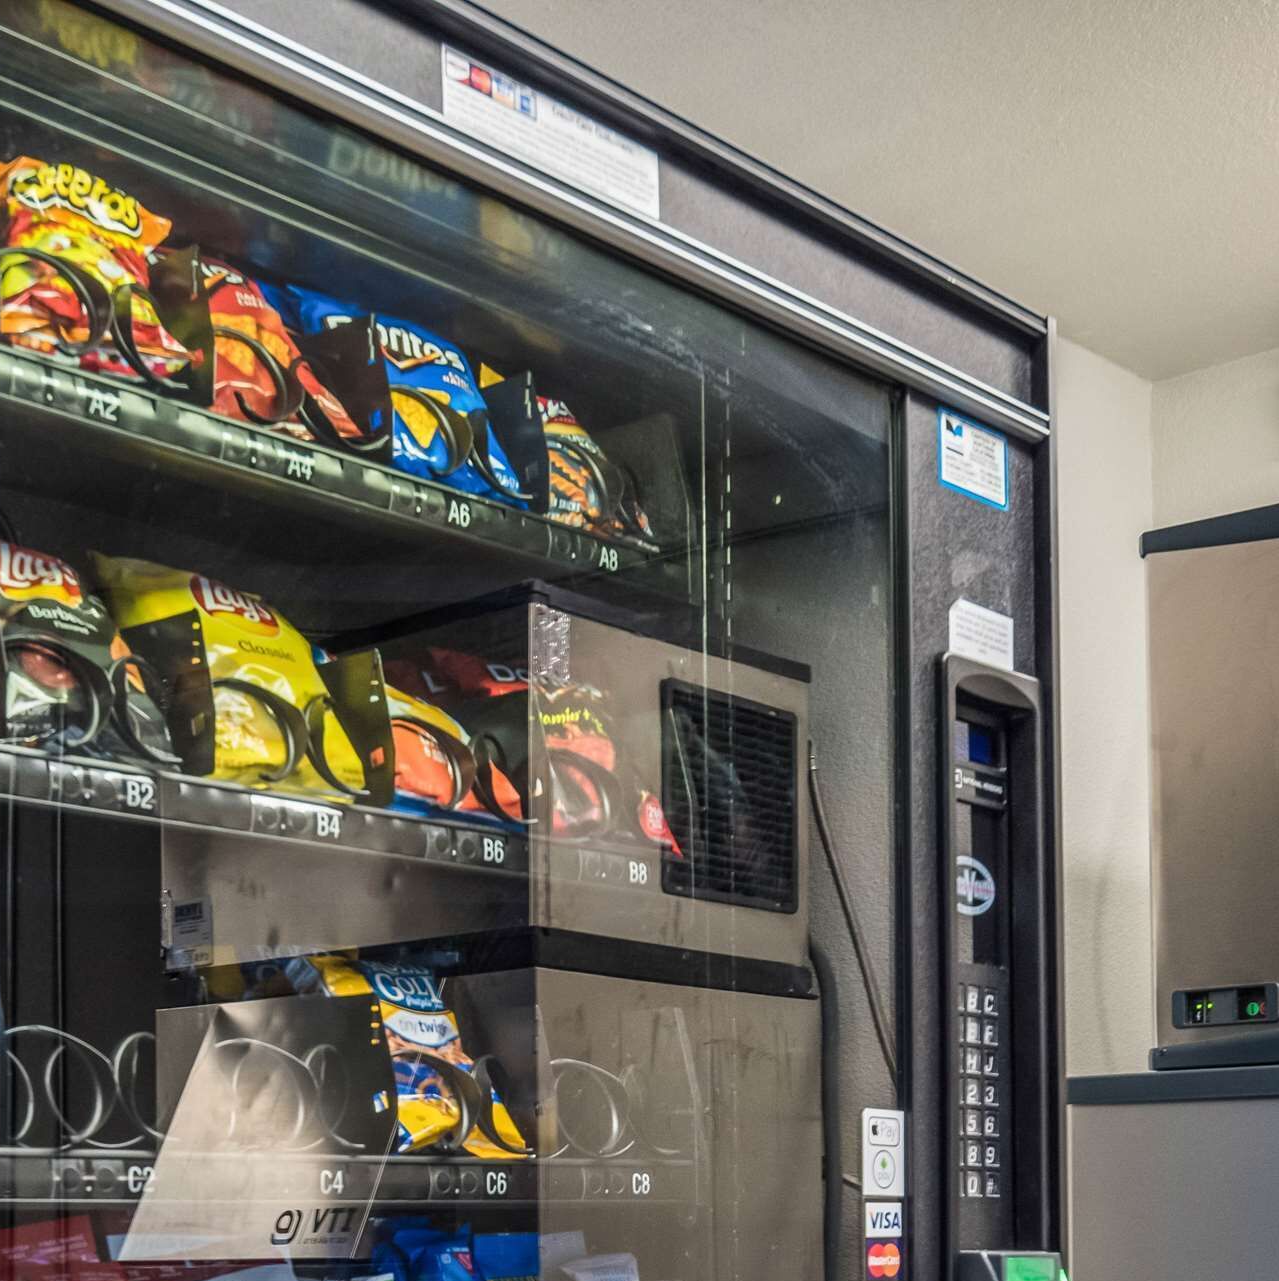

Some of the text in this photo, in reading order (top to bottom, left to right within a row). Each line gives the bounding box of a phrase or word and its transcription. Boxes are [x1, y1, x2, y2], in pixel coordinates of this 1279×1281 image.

[88, 398, 120, 422] A2
[286, 453, 314, 482] A4
[448, 501, 471, 529] A6
[600, 547, 618, 571] A8
[200, 577, 274, 622] Lay's
[126, 780, 154, 810] B2
[317, 812, 341, 840] B4
[483, 837, 505, 863] B6
[629, 860, 648, 885] B8
[984, 1086, 995, 1103] 3
[984, 1116, 995, 1133] 6
[985, 1146, 996, 1164] 9
[127, 1165, 156, 1194] C2
[320, 1169, 345, 1195] C4
[486, 1171, 508, 1195] C6
[632, 1172, 651, 1195] C8
[870, 1211, 901, 1229] VISA
